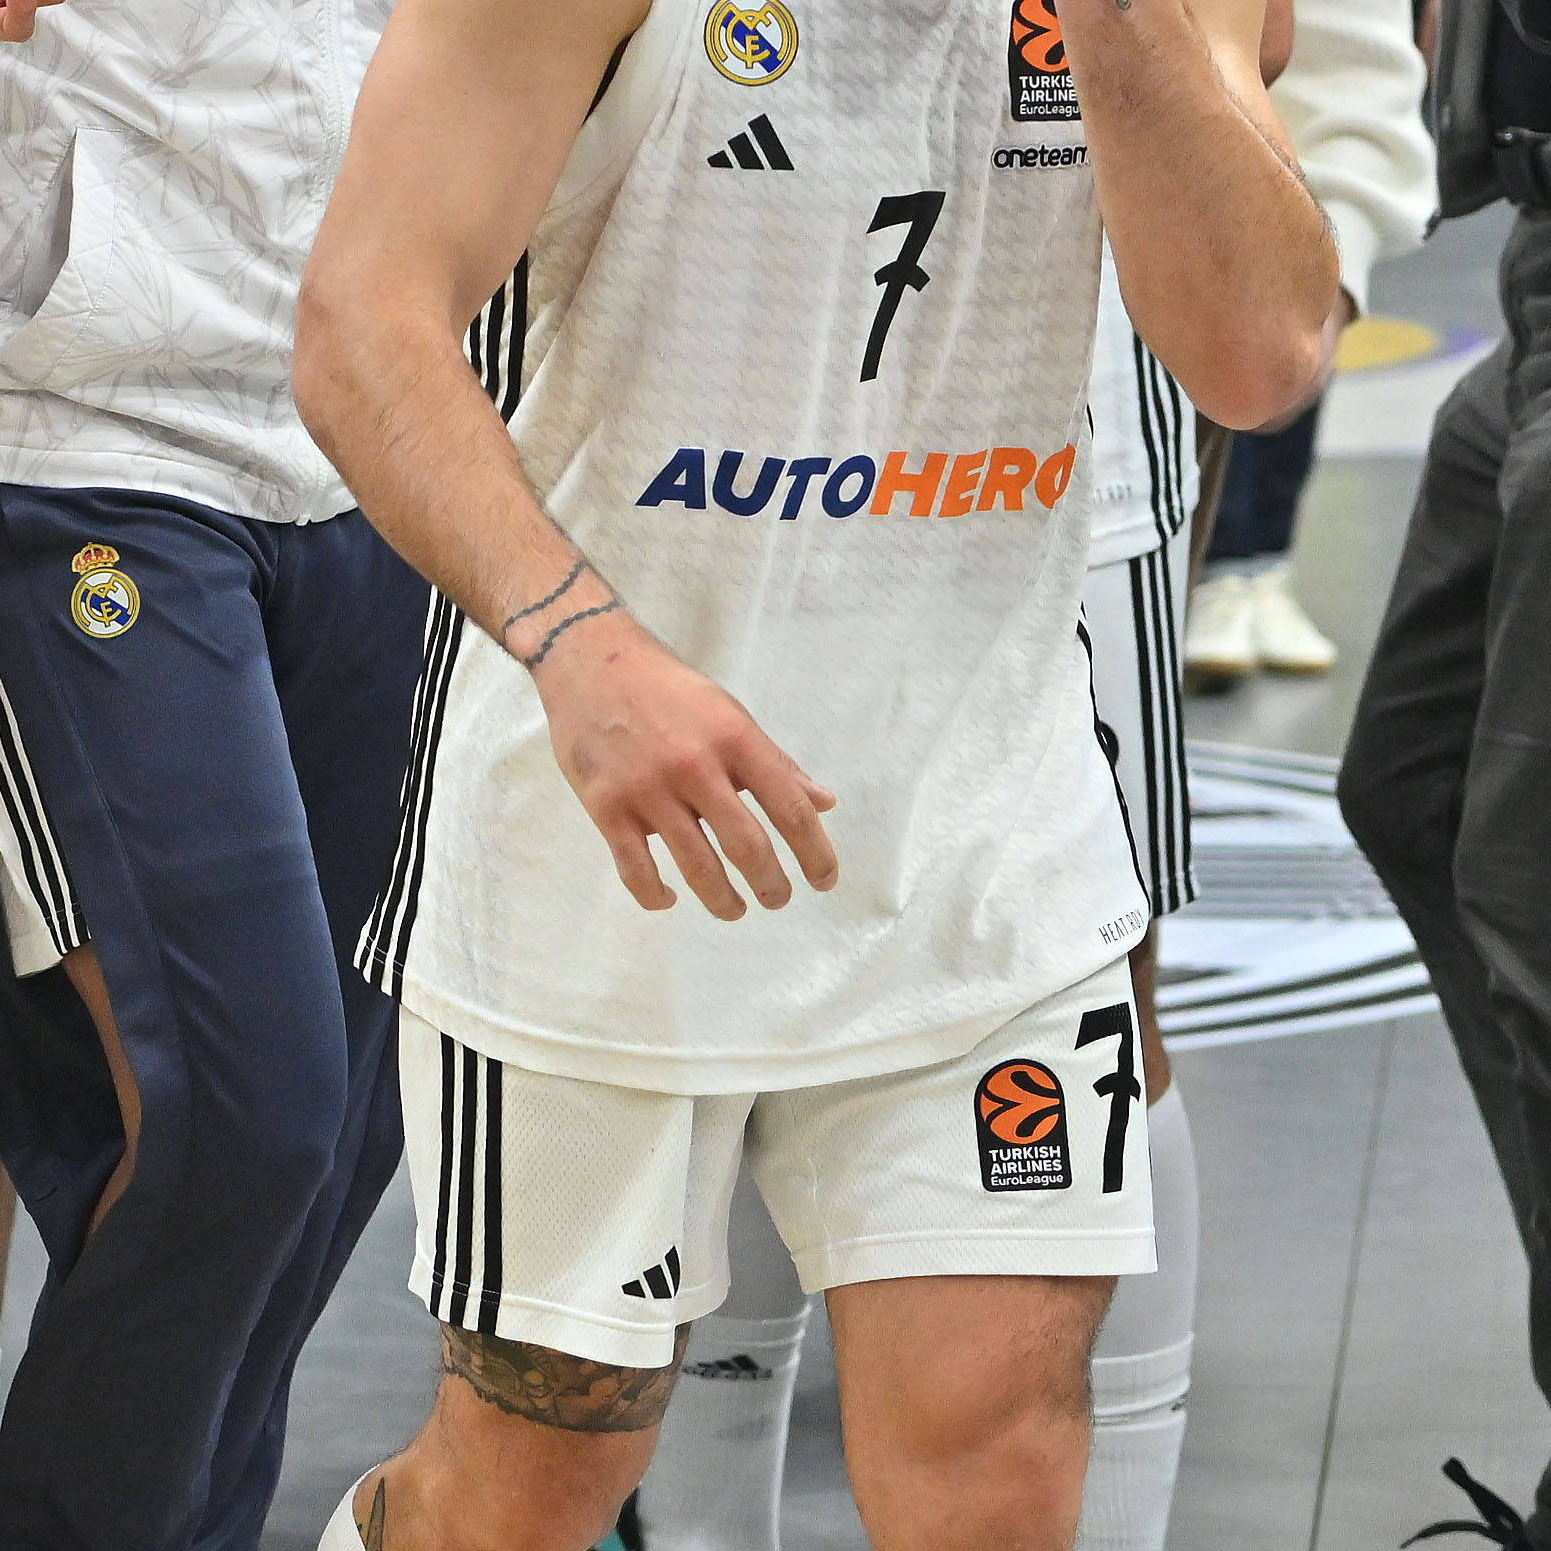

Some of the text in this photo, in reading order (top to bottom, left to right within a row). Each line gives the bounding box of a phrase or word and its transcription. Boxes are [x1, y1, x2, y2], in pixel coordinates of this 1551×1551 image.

[1018, 75, 1075, 89] TURKIS
[1020, 89, 1078, 103] AIRLINE
[1019, 103, 1081, 117] EuroLeagu
[859, 190, 946, 384] 7
[634, 441, 1077, 521] AUTOHERO
[1074, 1001, 1142, 1194] 7
[988, 1145, 1062, 1162] TURKISH
[990, 1159, 1063, 1176] AIRLINES
[990, 1174, 1064, 1186] EuroLeague
